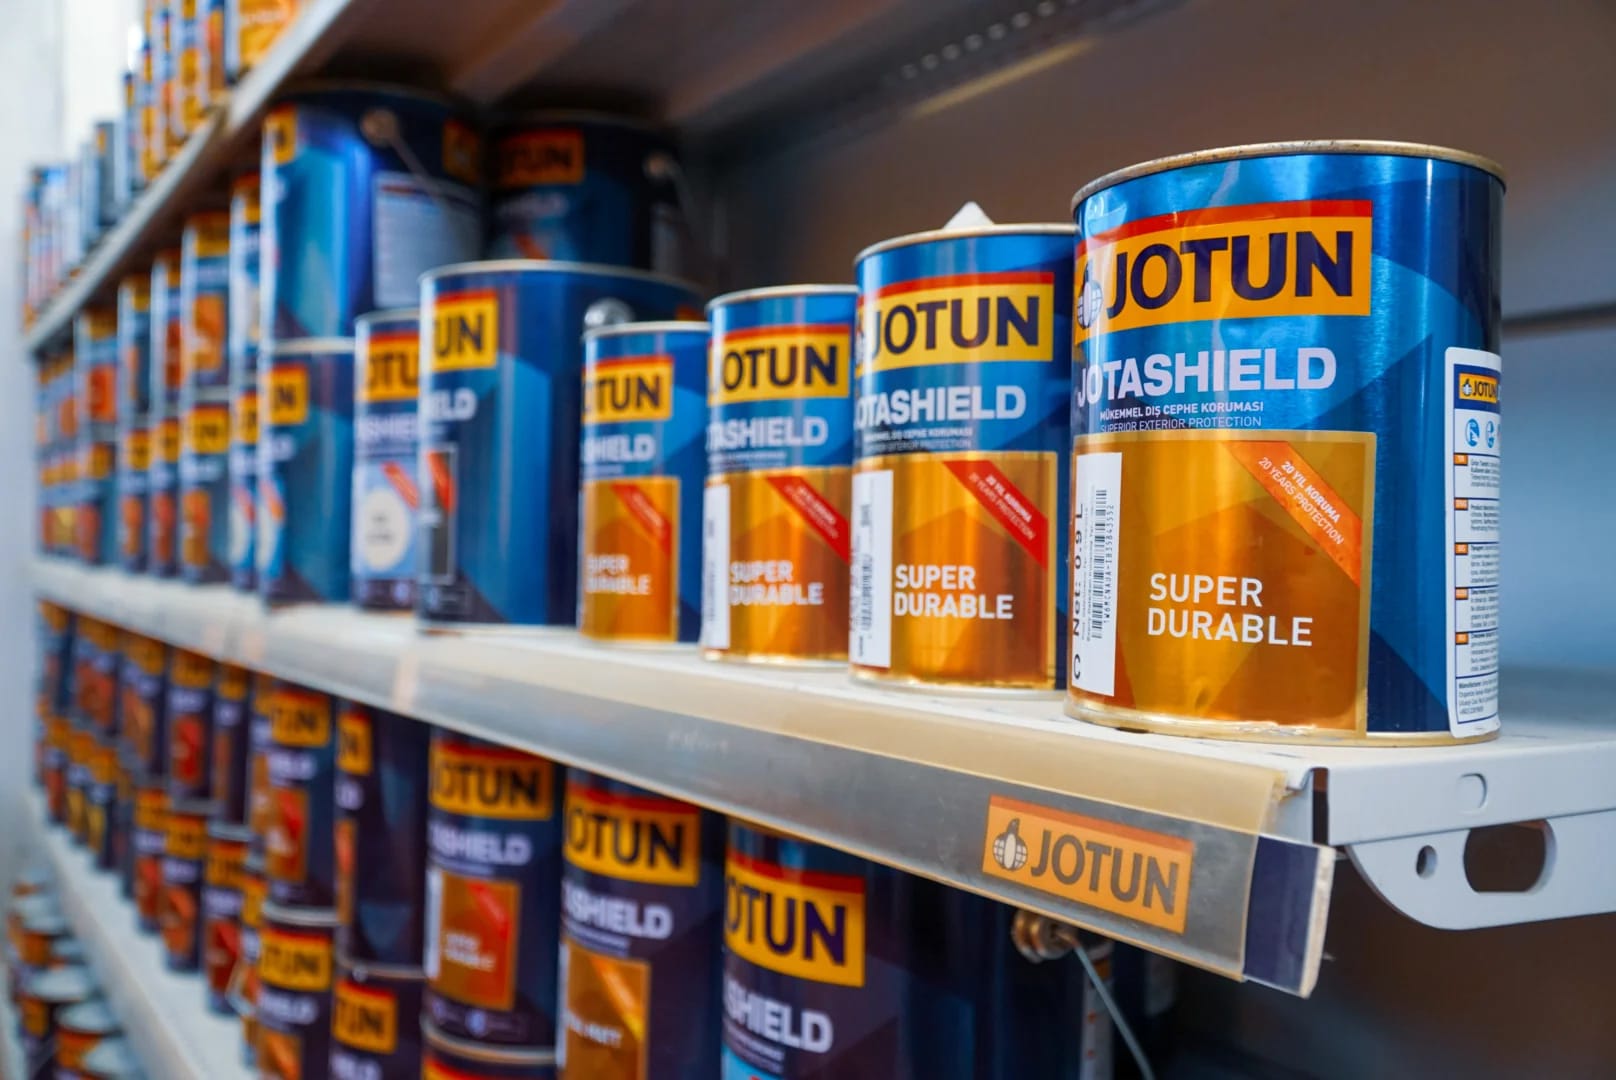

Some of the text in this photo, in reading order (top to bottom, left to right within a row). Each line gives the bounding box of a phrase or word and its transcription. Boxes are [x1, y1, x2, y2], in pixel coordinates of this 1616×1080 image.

[1105, 230, 1354, 320] JOTUN
[1077, 347, 1338, 408] JOTASHIELD
[1100, 415, 1262, 433] SUPERIOR EXTERIOR PROTECTION
[1163, 402, 1199, 415] CEPHE
[1201, 401, 1264, 413] KORUMASI
[1258, 457, 1345, 545] 20 YEARS PROTECTION
[1281, 461, 1295, 474] 20
[1304, 484, 1341, 524] KORUMA
[731, 560, 794, 584] SUPER
[895, 563, 976, 590] SUPER
[1149, 573, 1263, 608] SUPER
[893, 592, 1014, 620] DURABLE
[1147, 607, 1313, 647] DURABLE
[1030, 829, 1180, 916] JOTUN
